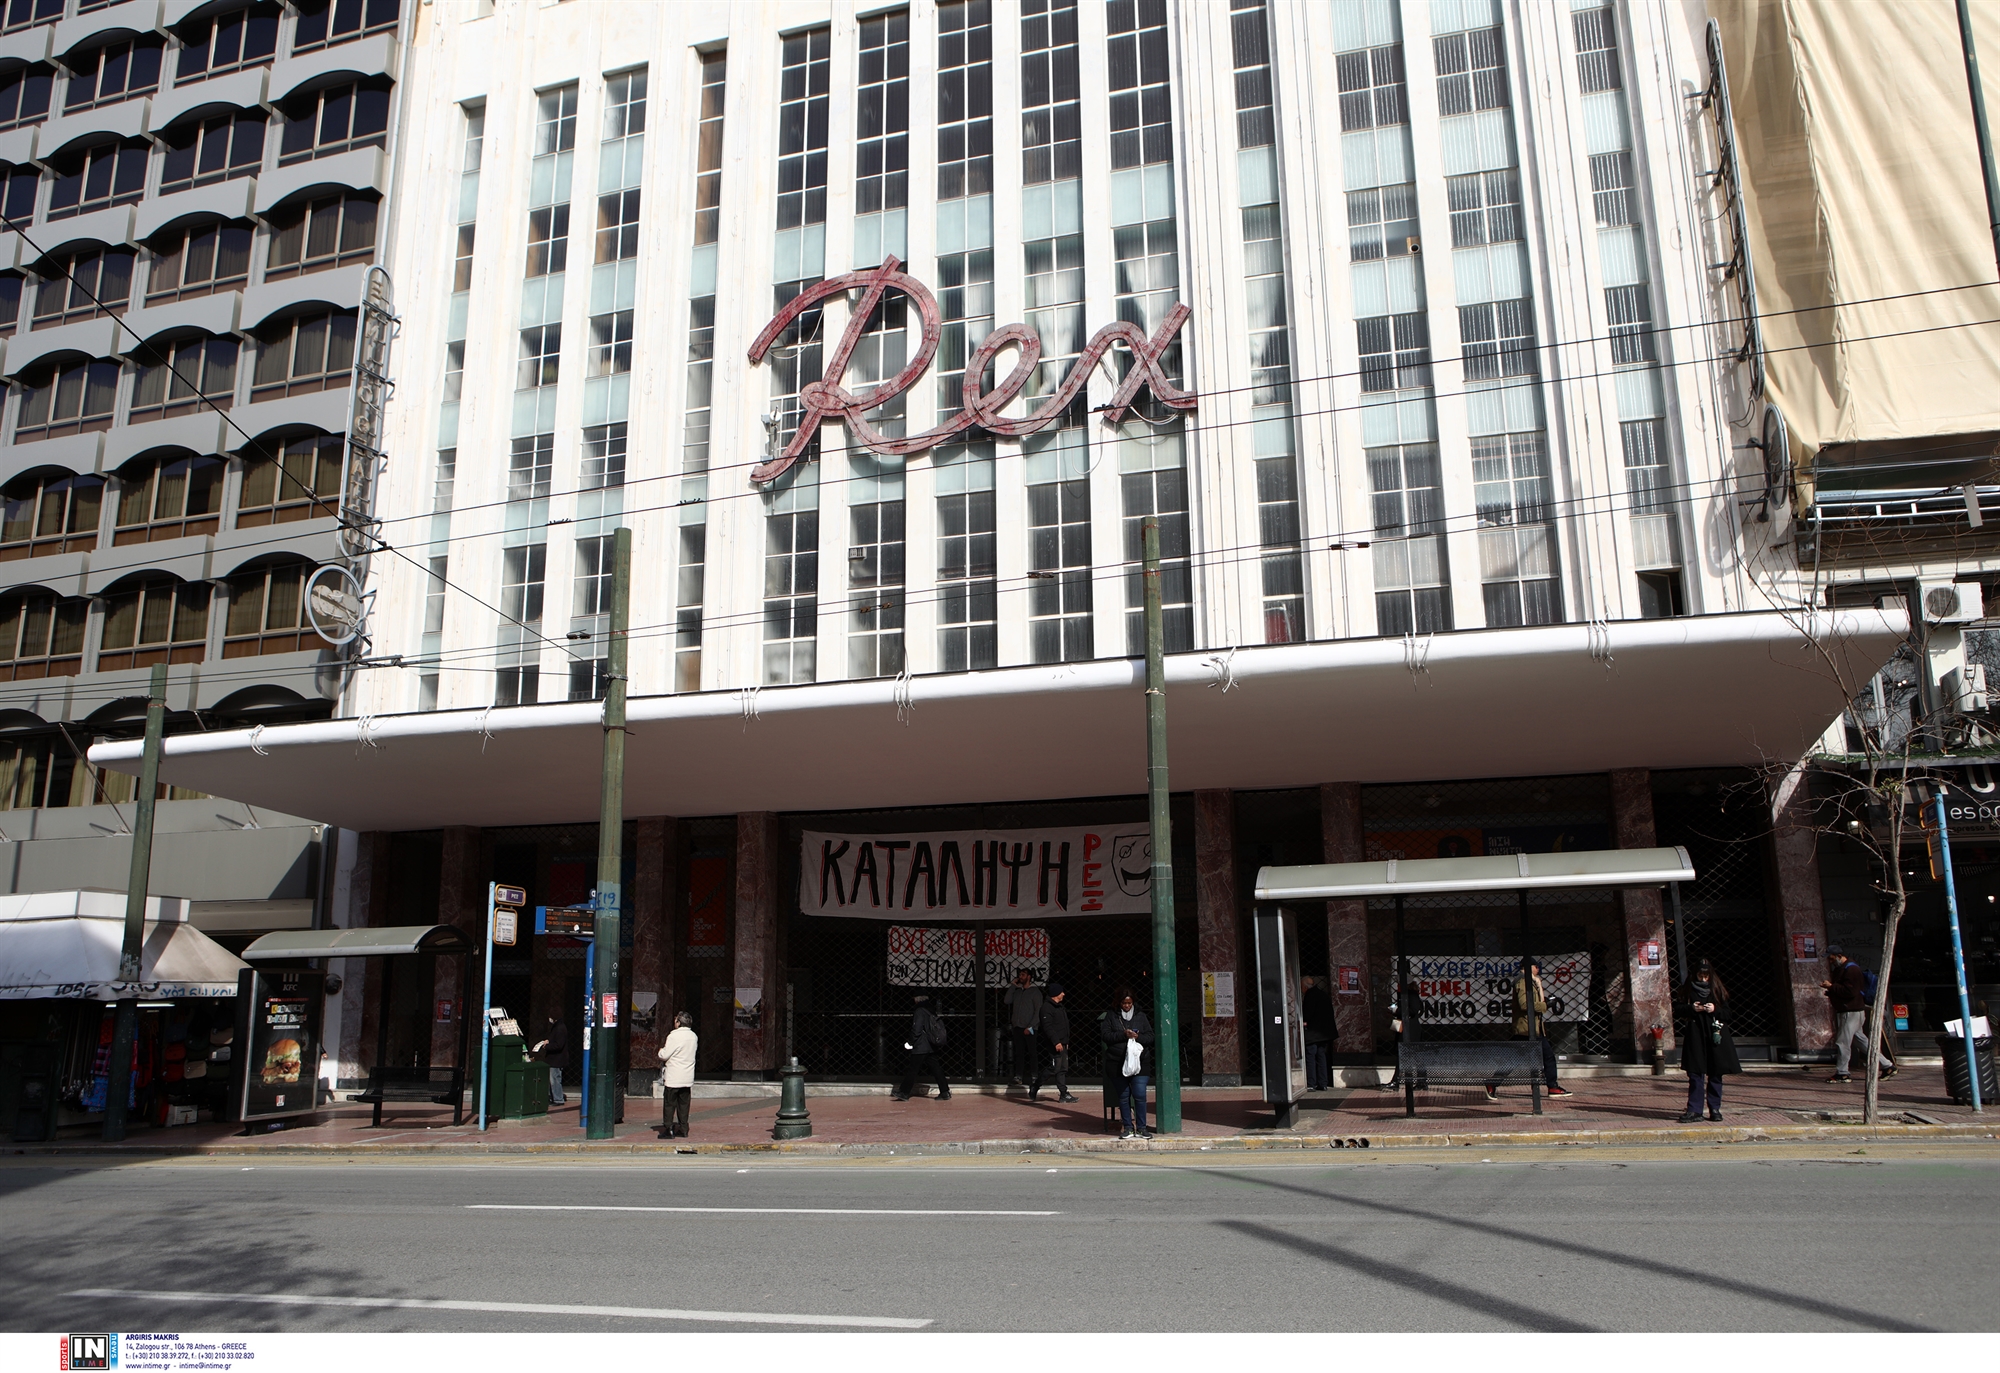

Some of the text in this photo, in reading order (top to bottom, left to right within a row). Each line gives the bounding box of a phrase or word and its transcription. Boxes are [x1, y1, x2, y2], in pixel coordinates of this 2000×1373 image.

[748, 254, 1197, 482] Rex
[820, 840, 1070, 911] ΚΑΤΑΛΗΨΗ
[889, 927, 929, 954] ΟΧΙ
[282, 983, 299, 992] KFC
[1418, 1000, 1477, 1019] ΝΙΚΟ
